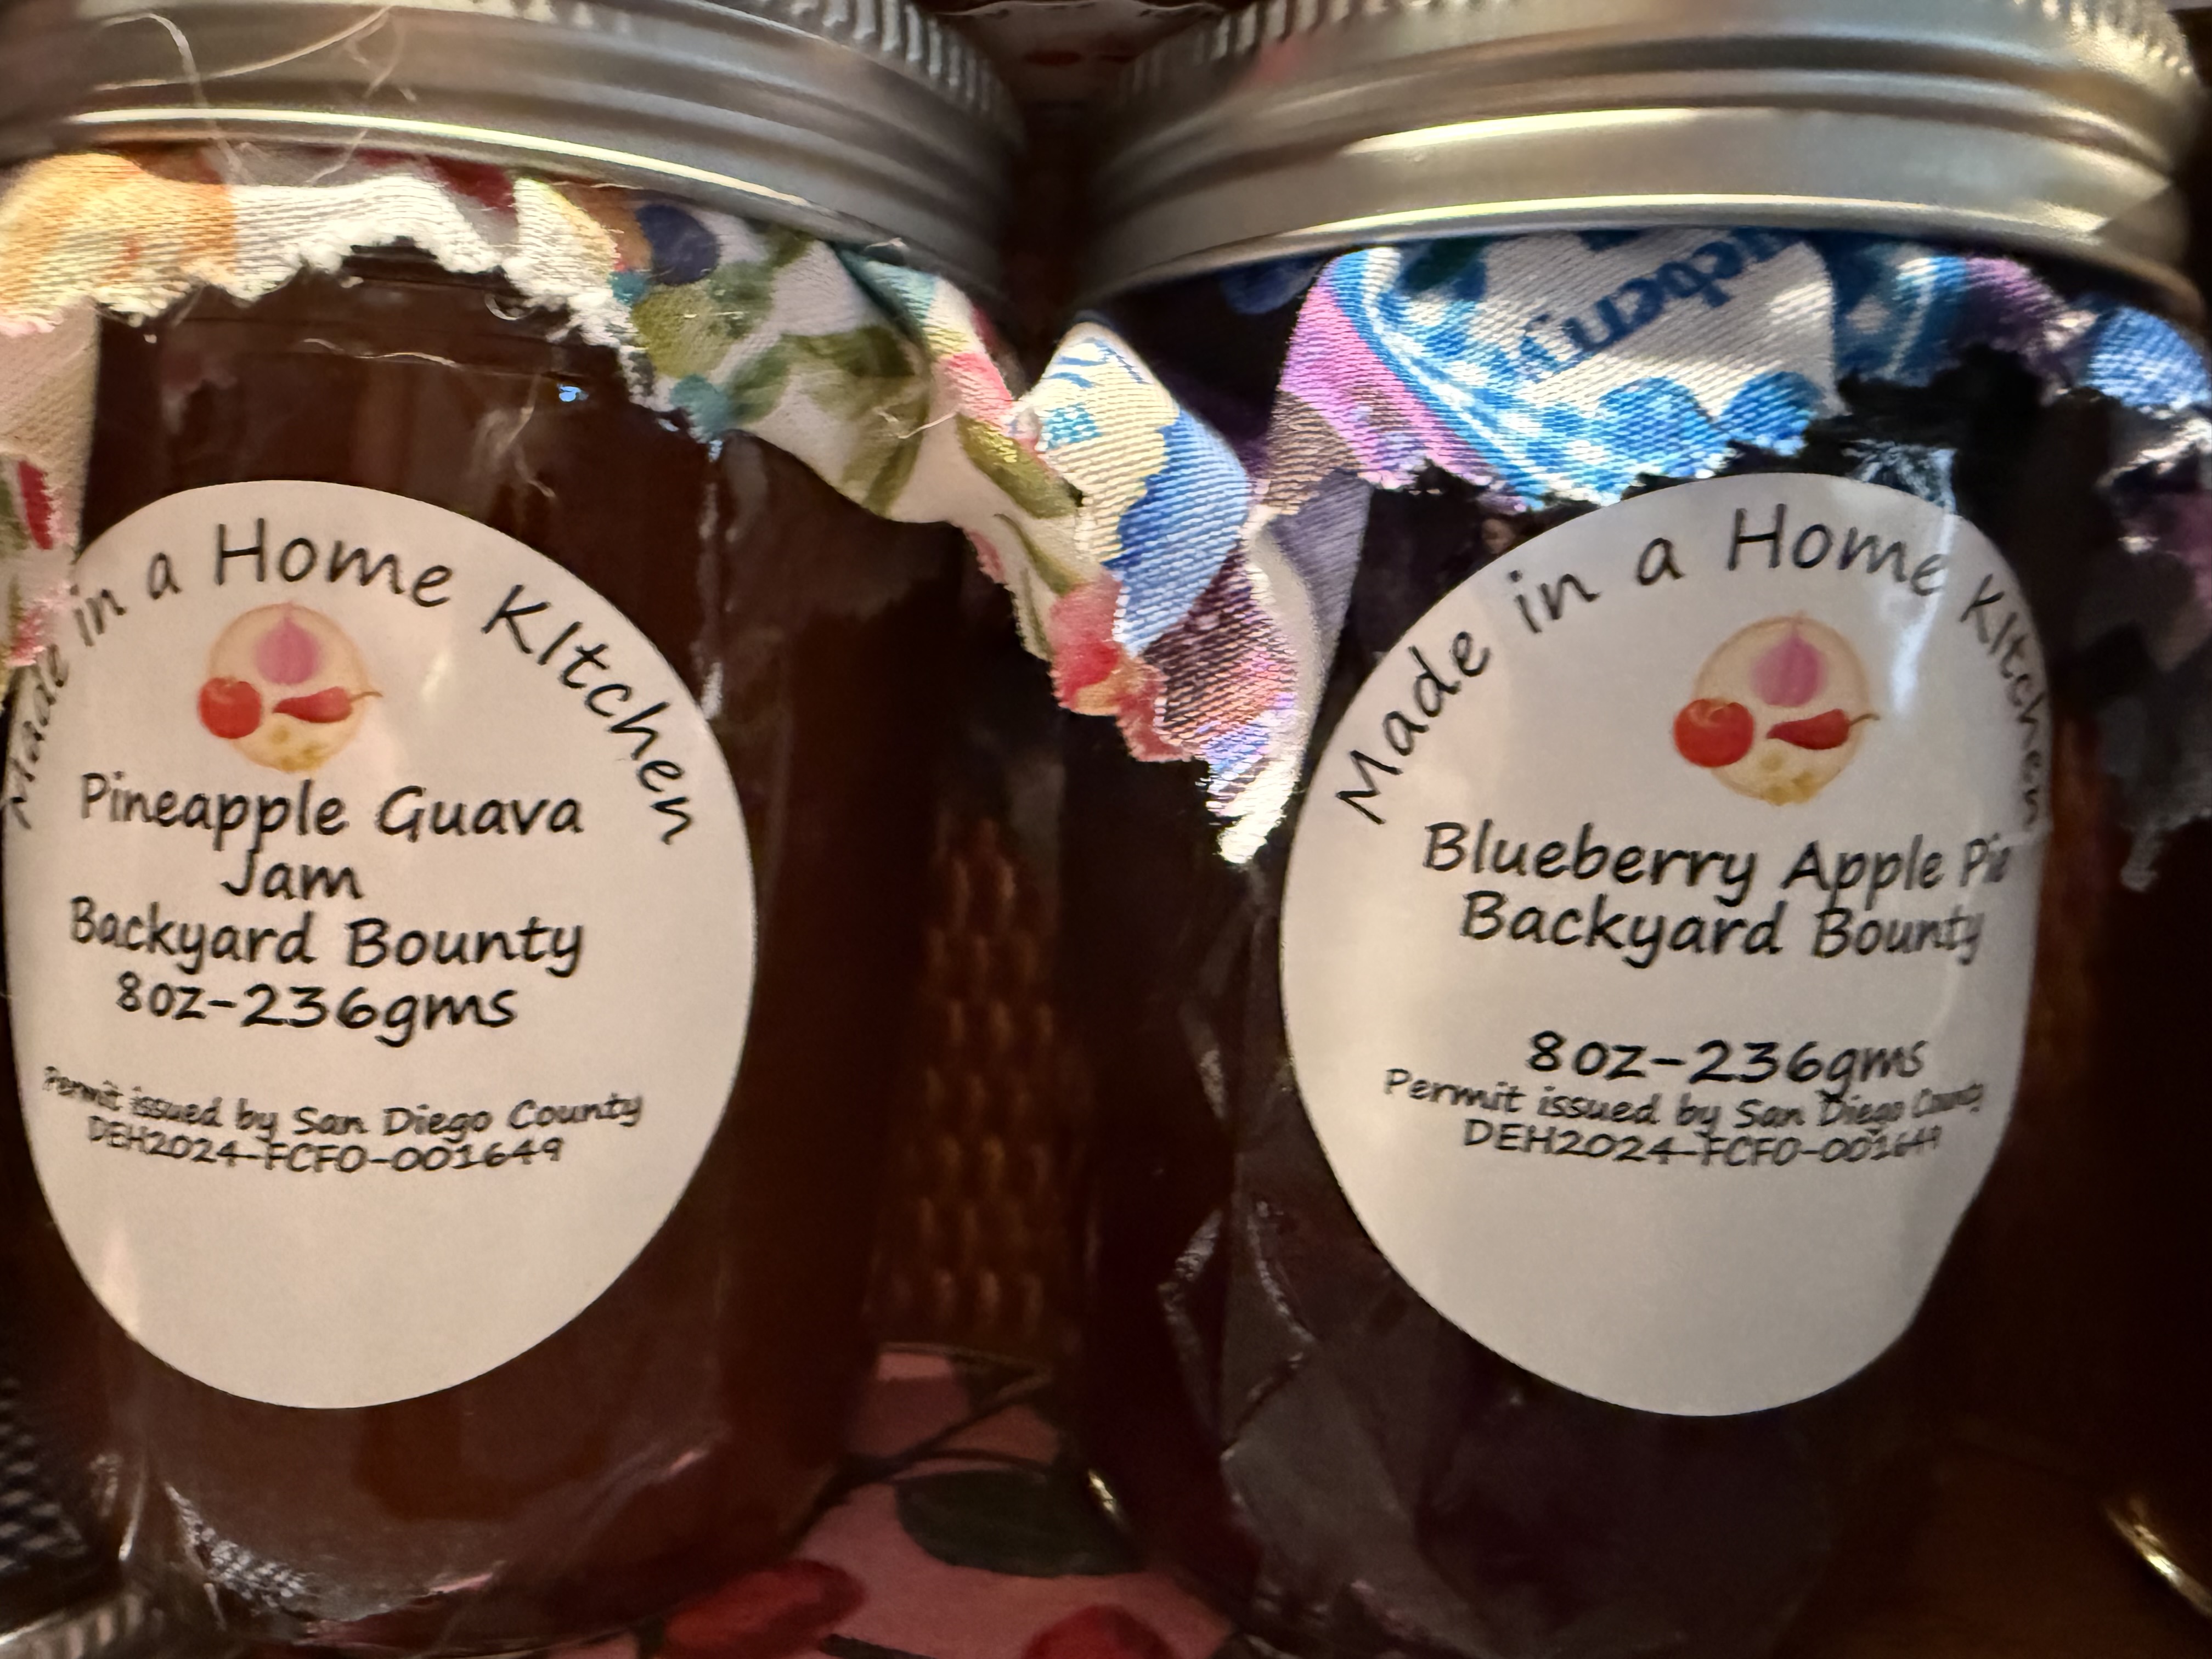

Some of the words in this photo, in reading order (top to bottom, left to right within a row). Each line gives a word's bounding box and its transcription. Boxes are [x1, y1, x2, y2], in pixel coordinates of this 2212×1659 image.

[70, 585, 127, 646] in
[148, 552, 182, 599] a
[213, 517, 453, 608] Home
[1335, 631, 1491, 825] Made
[1508, 569, 1601, 634] in
[1637, 537, 1685, 586] a
[1728, 503, 1949, 596] Home
[81, 772, 349, 854] Pineapple
[375, 786, 584, 842] Guava
[221, 848, 364, 899] Jam
[1423, 819, 1757, 907] Blueberry
[1779, 834, 1945, 911] Apple
[69, 895, 317, 975] Backyard
[347, 916, 583, 977] Bounty
[1459, 890, 1784, 969] Backyard
[1812, 904, 1984, 967] Bounty
[236, 1098, 278, 1142] by
[294, 1106, 370, 1135] San
[383, 1104, 493, 1143] Diego
[508, 1093, 642, 1129] County
[1384, 1069, 1526, 1113] Permit
[1536, 1085, 1660, 1125] issued
[1675, 1092, 1721, 1139] by
[1733, 1099, 1805, 1128] San
